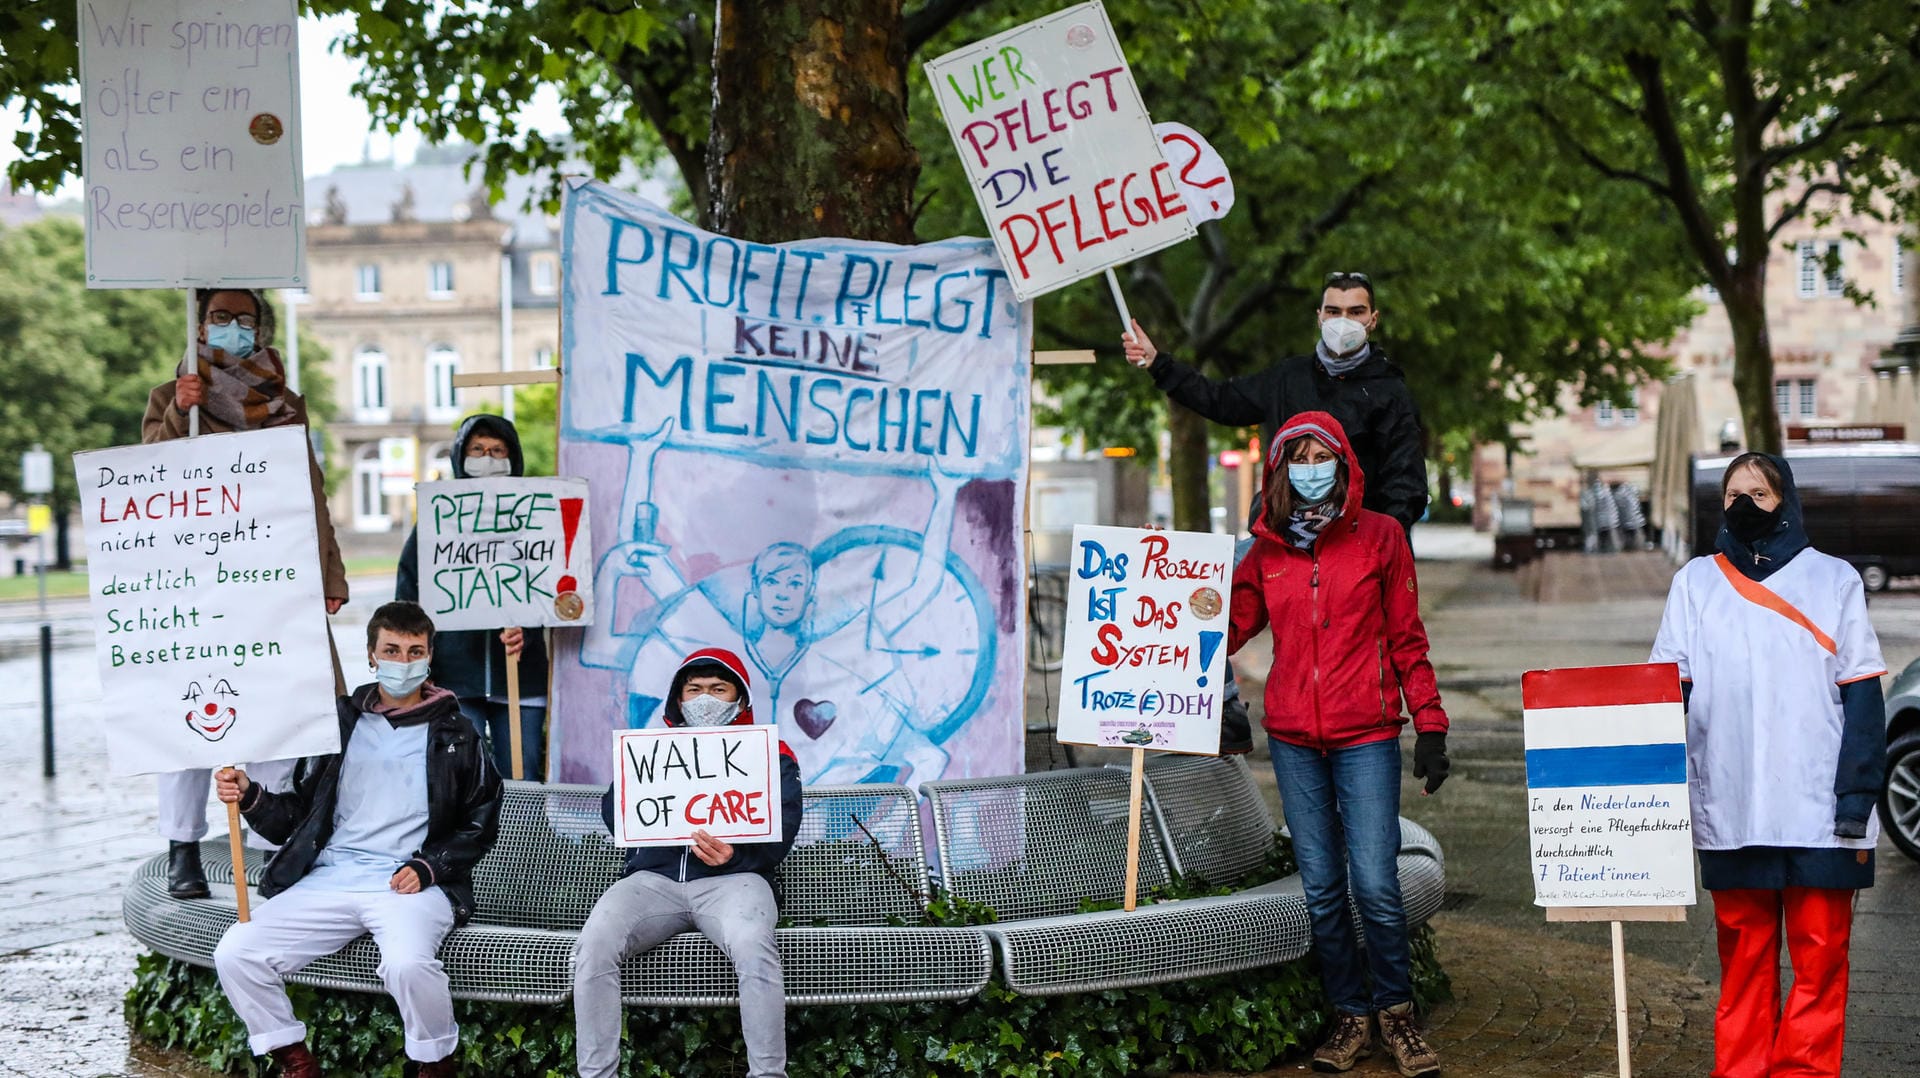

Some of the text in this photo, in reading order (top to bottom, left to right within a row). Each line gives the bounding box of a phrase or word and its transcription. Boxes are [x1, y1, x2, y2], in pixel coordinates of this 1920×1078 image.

[88, 2, 293, 69] Wir springen
[98, 67, 250, 130] öfter ein
[947, 46, 1035, 113] WER
[961, 66, 1124, 168] PFLEGT
[104, 130, 233, 172] als ein
[982, 148, 1070, 209] DIE
[91, 185, 302, 248] Reservespieler
[735, 316, 882, 373] KEINE
[622, 353, 982, 458] MENSCHEN
[97, 451, 268, 488] Damit uns das
[100, 483, 242, 523] LACHEN
[431, 491, 556, 535] PFLEGE
[101, 518, 272, 555] nicht vergeht:
[433, 540, 555, 565] MACHT SICH
[102, 561, 296, 595] deutlich bessere
[1077, 535, 1225, 584] DAS PROBLEM
[433, 563, 554, 614] STARK
[1088, 586, 1182, 633] IST DAS
[111, 641, 282, 667] Besetzungen
[1091, 623, 1190, 672] SYSTEM
[626, 737, 748, 784] WALK
[636, 789, 766, 827] OF CARE
[1531, 794, 1670, 812] In den Niederlanden
[1534, 818, 1690, 837] versorgt eine Pflegefachkraft
[1535, 843, 1614, 858] durchschnittlich
[1539, 864, 1548, 882] 7
